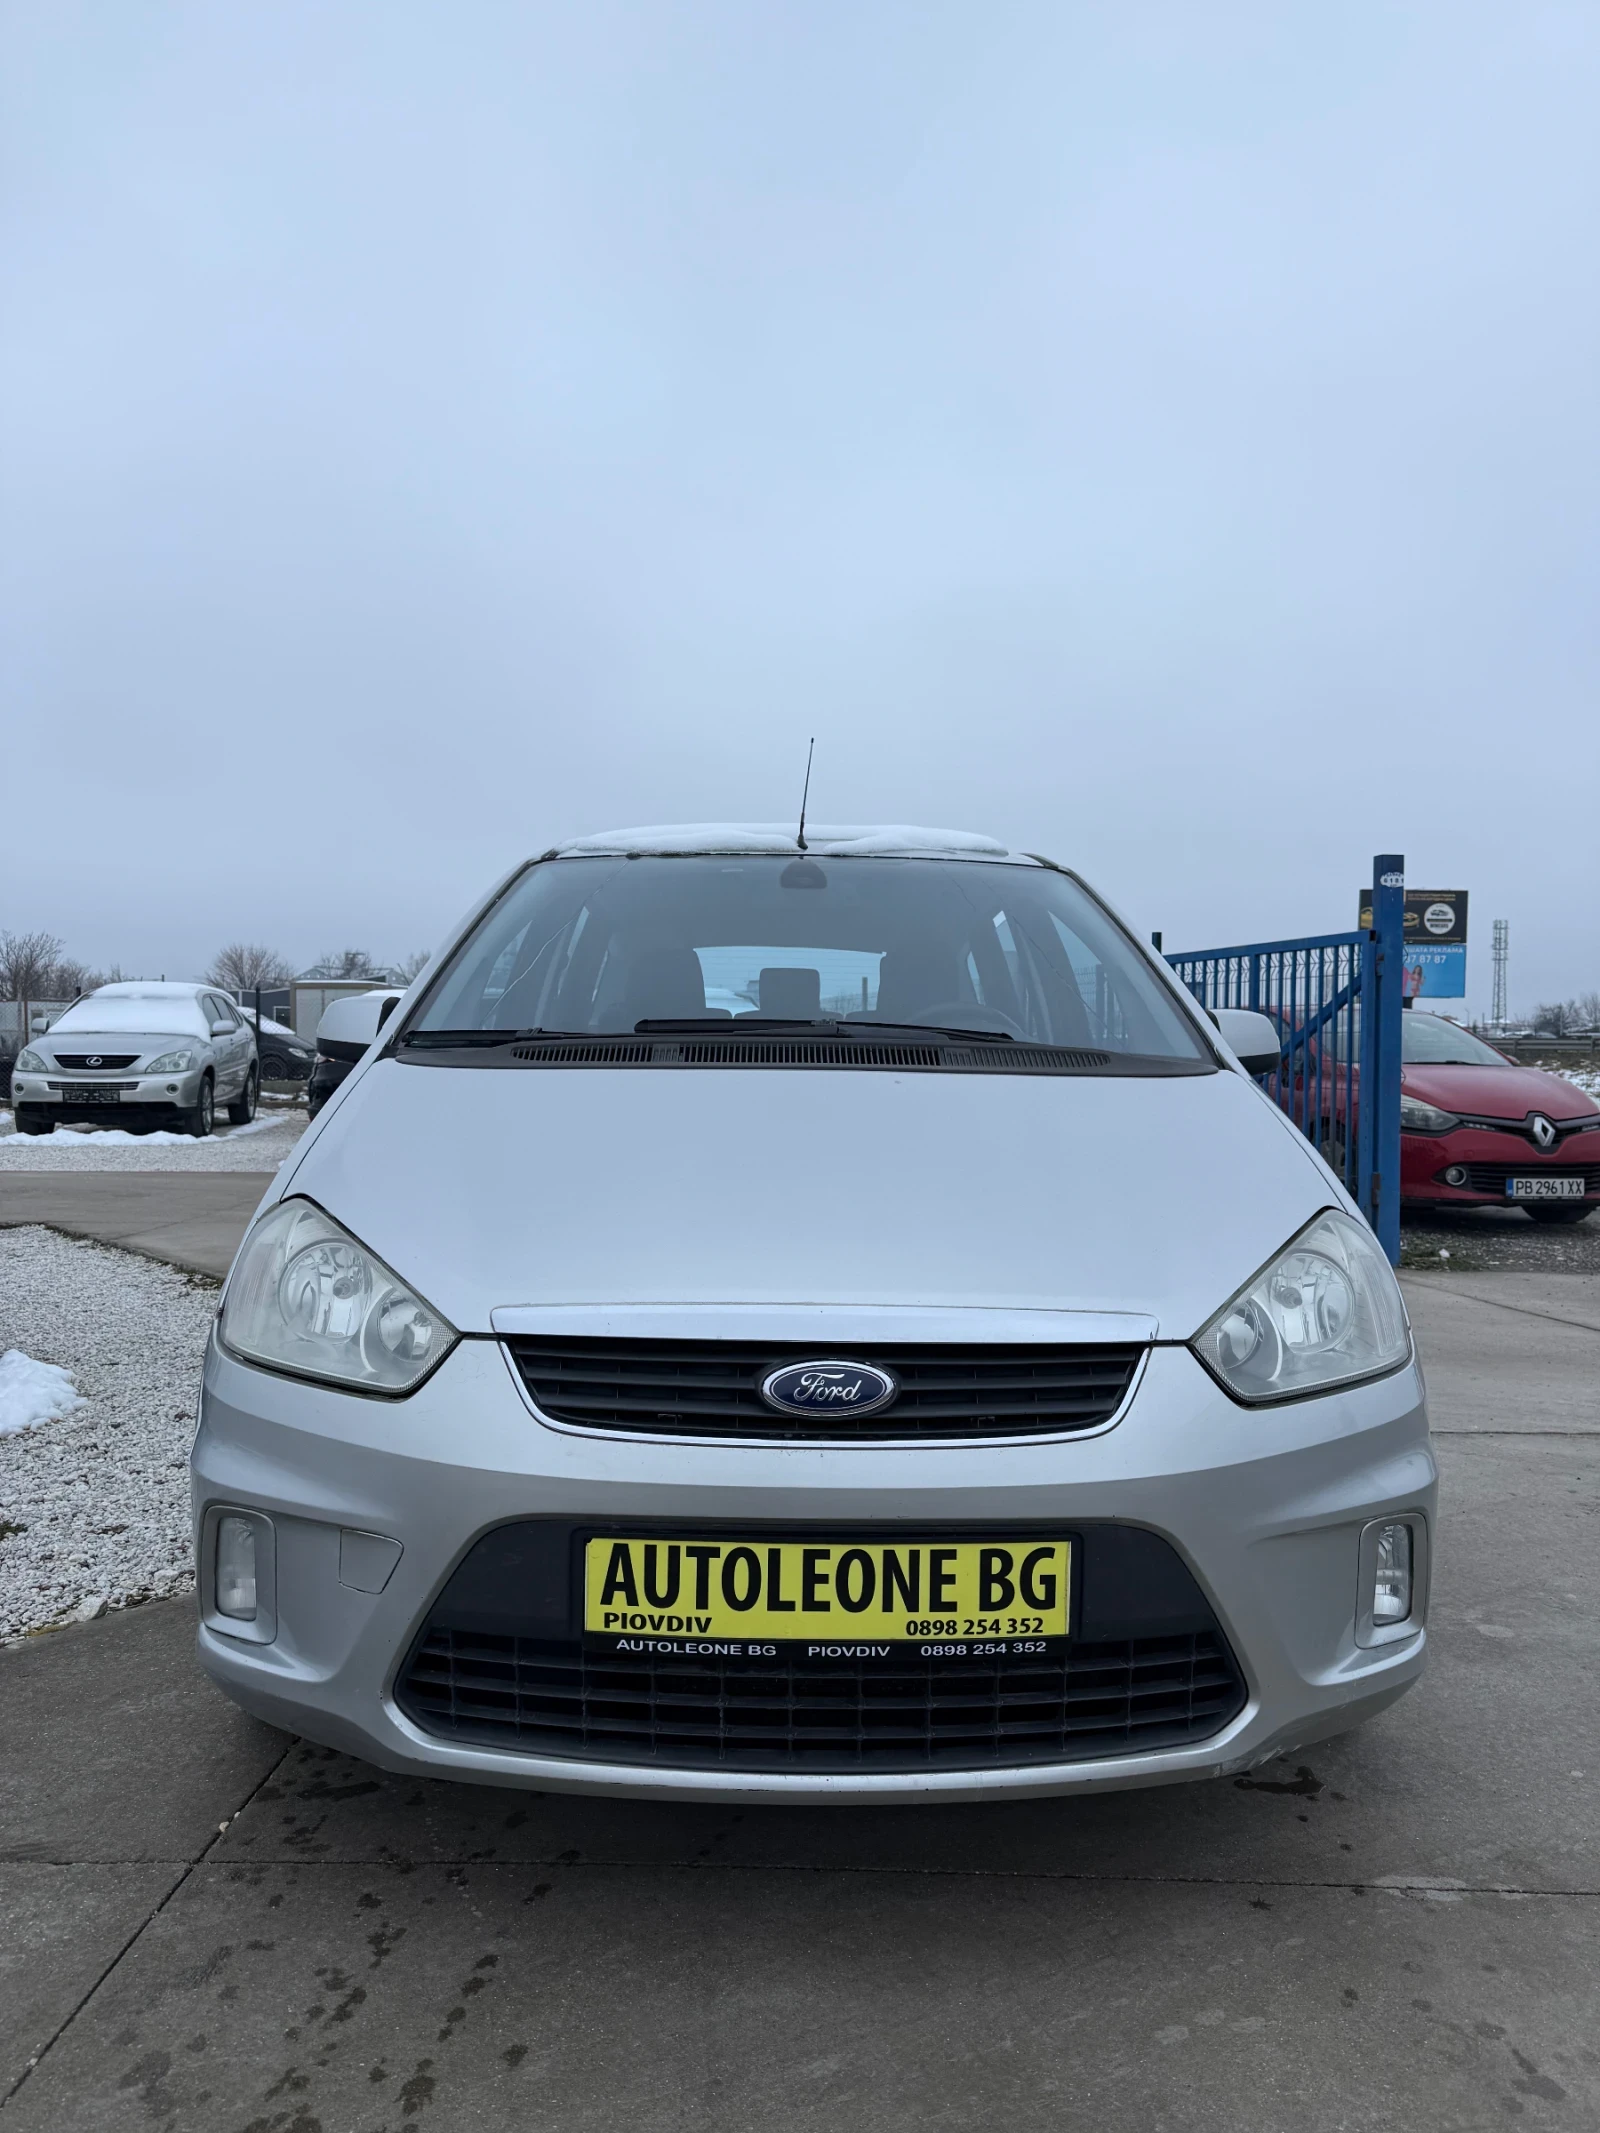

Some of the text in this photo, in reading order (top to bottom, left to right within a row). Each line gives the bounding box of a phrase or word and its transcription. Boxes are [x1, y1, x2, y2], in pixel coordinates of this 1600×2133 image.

[1419, 954, 1431, 964] 87
[1434, 954, 1447, 964] 87
[1515, 1180, 1583, 1195] PB 2961 XX
[793, 1372, 862, 1402] Ford
[599, 1542, 1057, 1614] AUTOLEONE BG
[603, 1611, 713, 1634] PIOVDIV
[905, 1616, 1045, 1637] 0898 254 352
[616, 1639, 777, 1657] AUTOLEONE BG
[807, 1645, 891, 1658] PIOVDIV
[920, 1641, 1048, 1657] 0898 254 352
